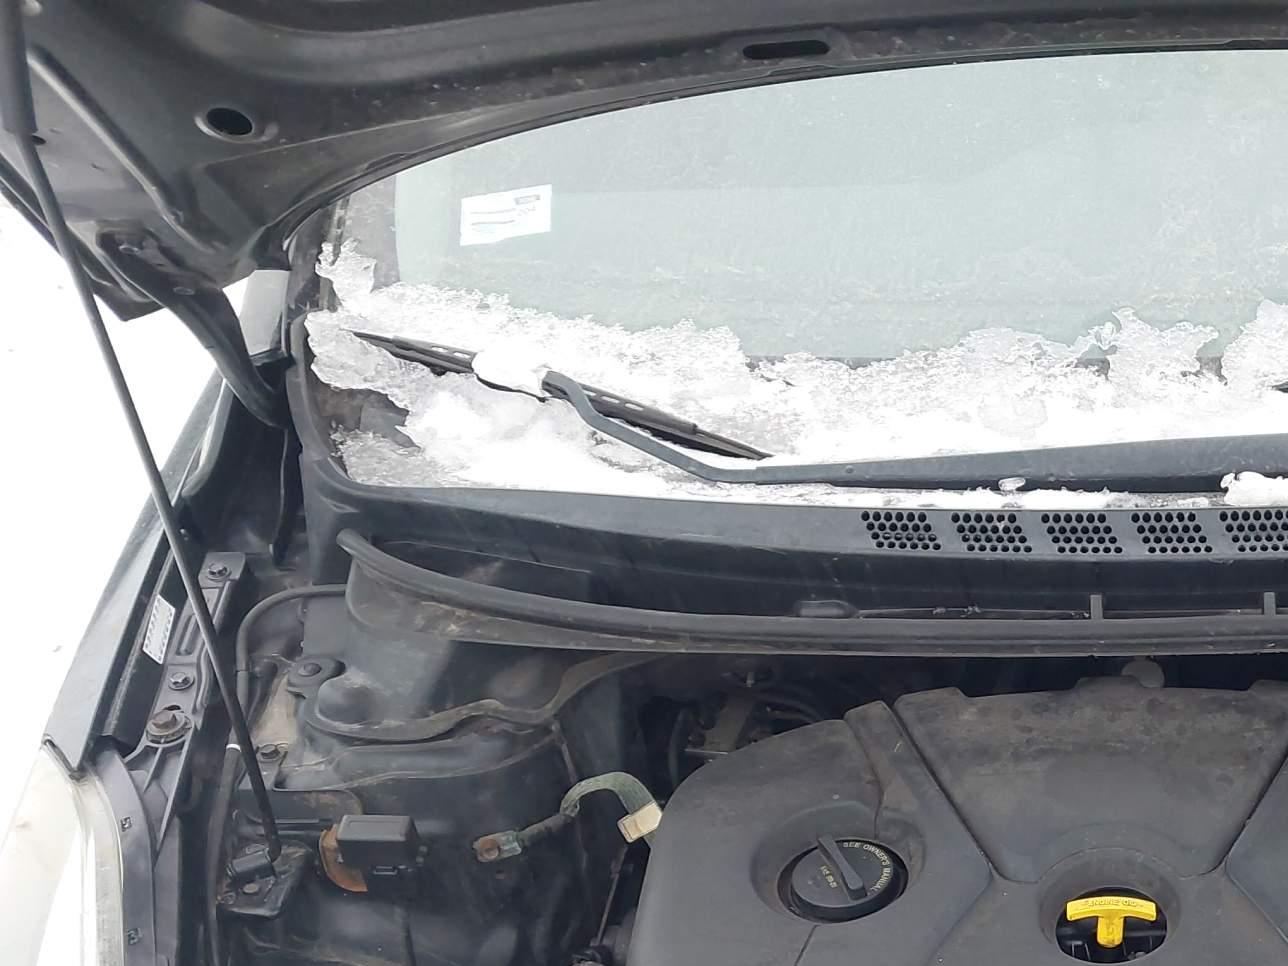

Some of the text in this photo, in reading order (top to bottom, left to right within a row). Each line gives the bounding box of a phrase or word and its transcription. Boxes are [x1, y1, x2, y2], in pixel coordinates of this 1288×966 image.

[842, 841, 892, 892] SEE OWNER'S MANUAL
